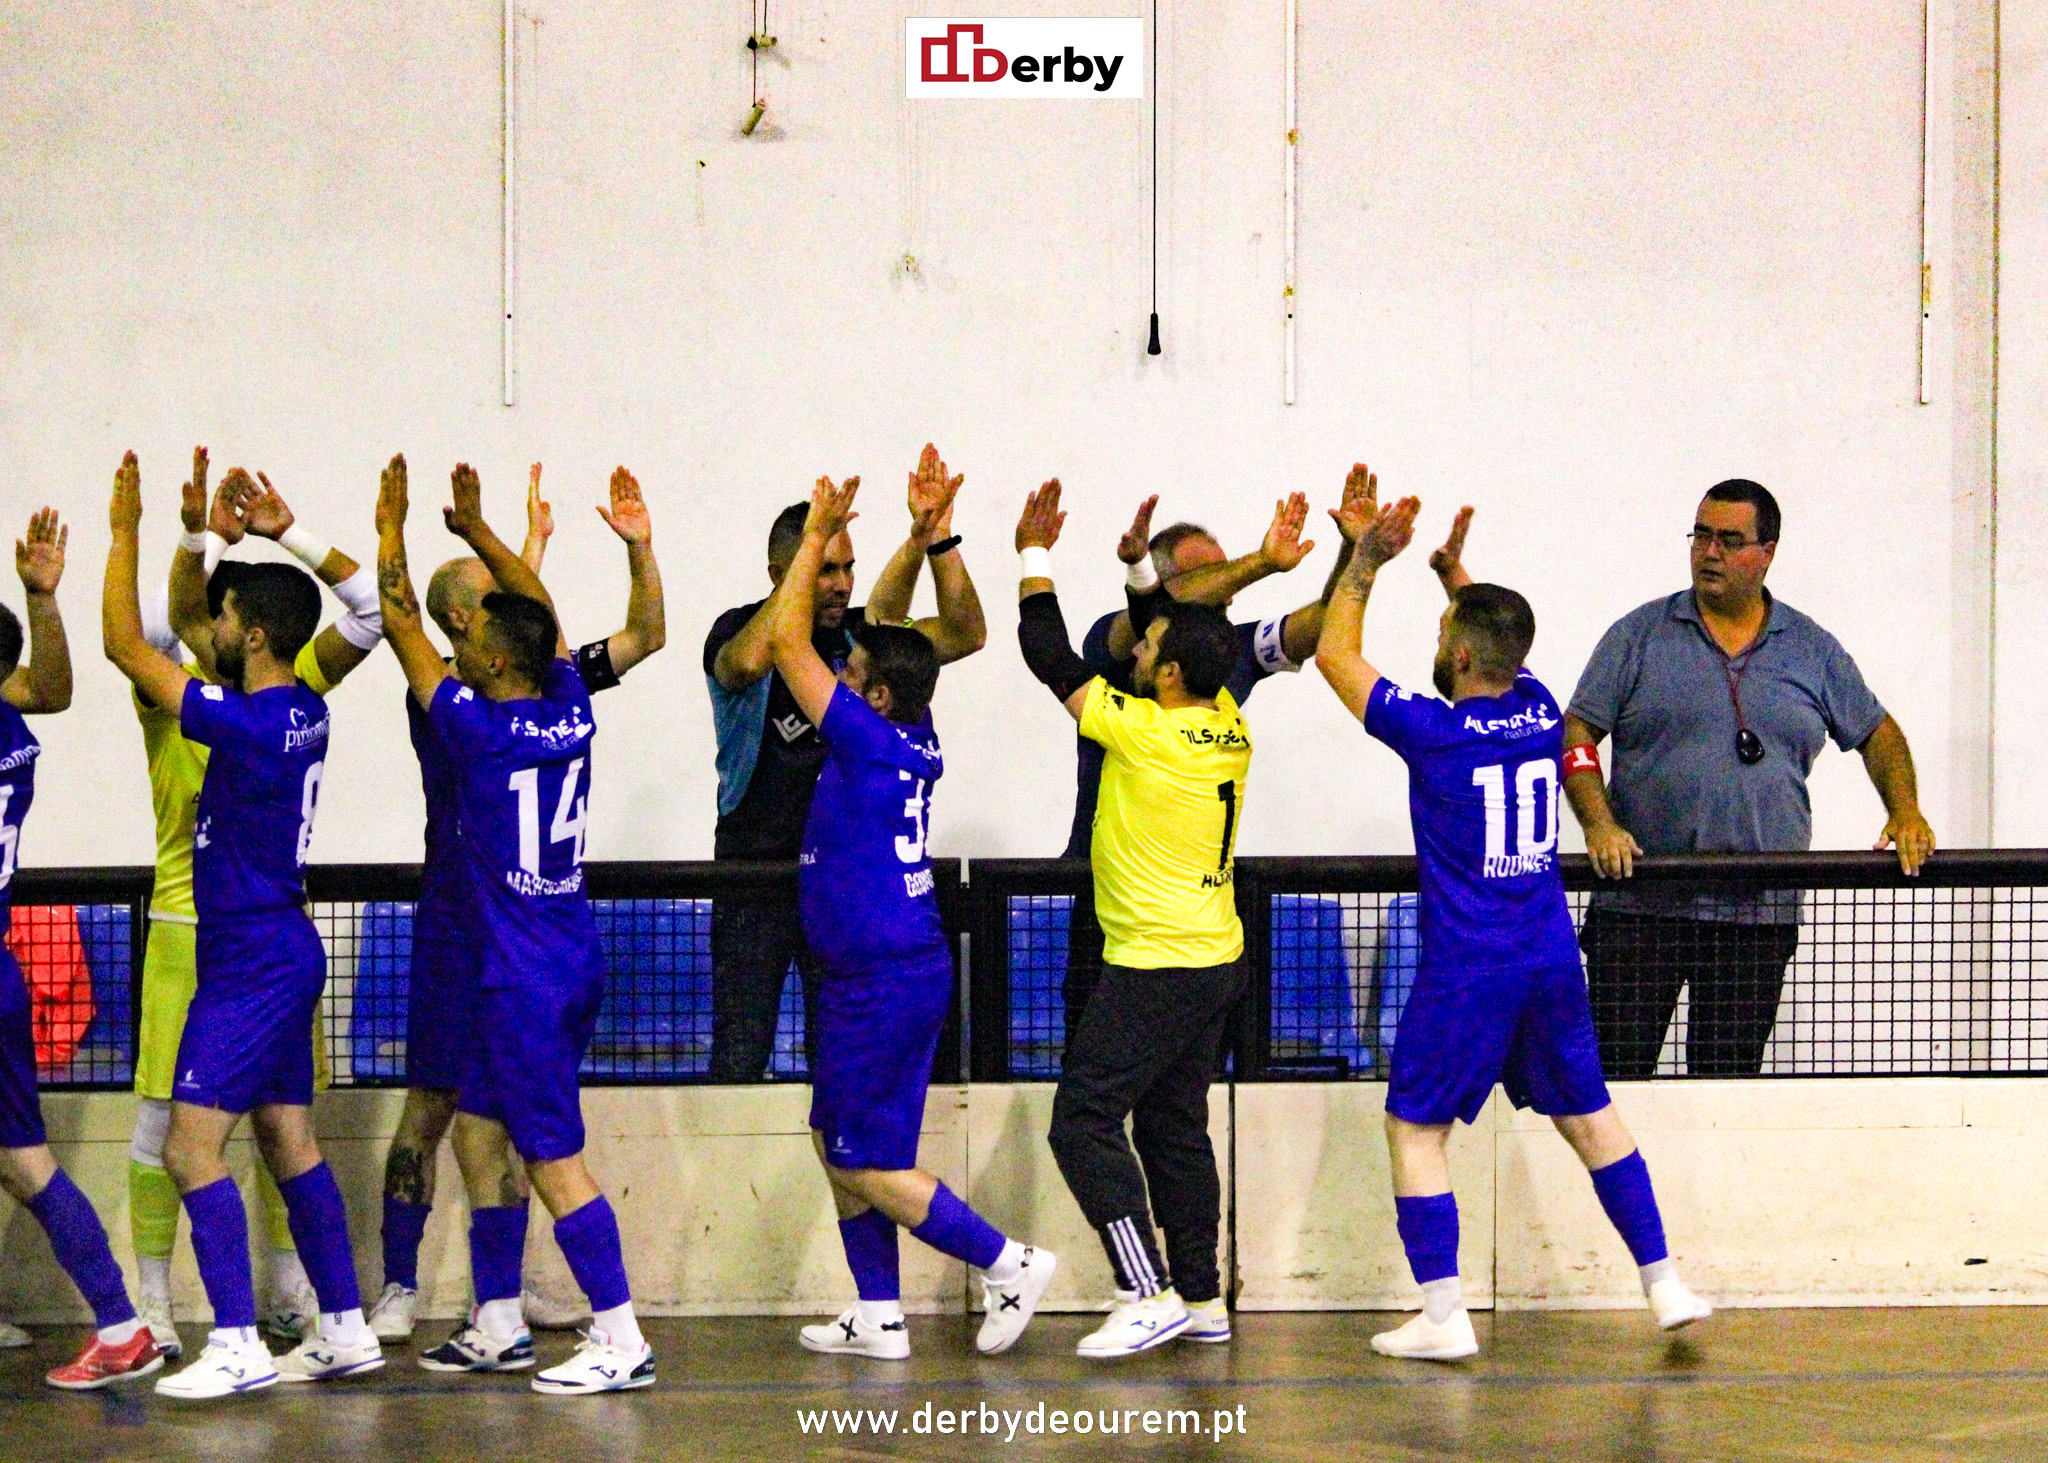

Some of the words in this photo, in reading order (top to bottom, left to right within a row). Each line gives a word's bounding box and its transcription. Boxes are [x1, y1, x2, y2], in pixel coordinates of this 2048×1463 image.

[296, 761, 323, 868] 8
[509, 757, 584, 878] 14
[1218, 779, 1236, 871] 1
[1472, 758, 1558, 857] 10
